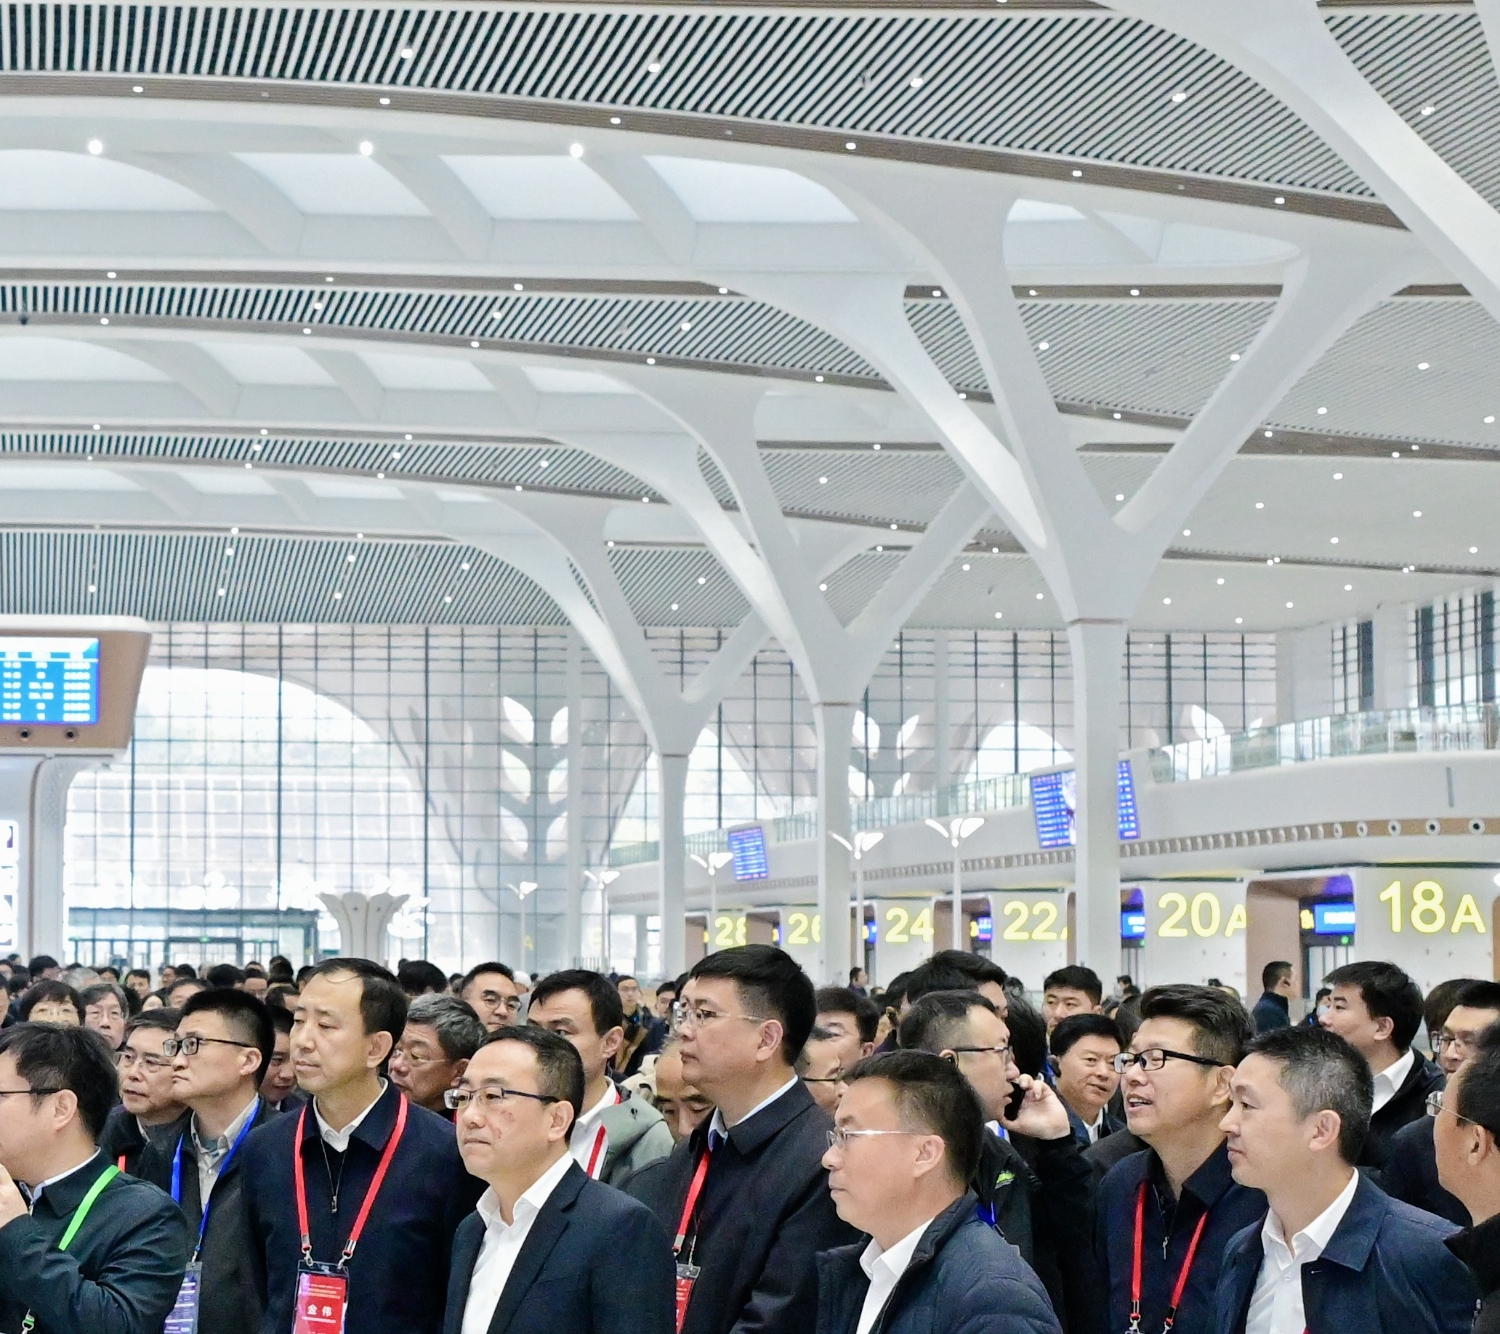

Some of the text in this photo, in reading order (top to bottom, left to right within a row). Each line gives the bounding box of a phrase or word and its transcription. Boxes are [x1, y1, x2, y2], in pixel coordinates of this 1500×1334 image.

[1003, 900, 1067, 942] 22
[1156, 892, 1247, 938] 20A
[1379, 880, 1487, 934] 18A
